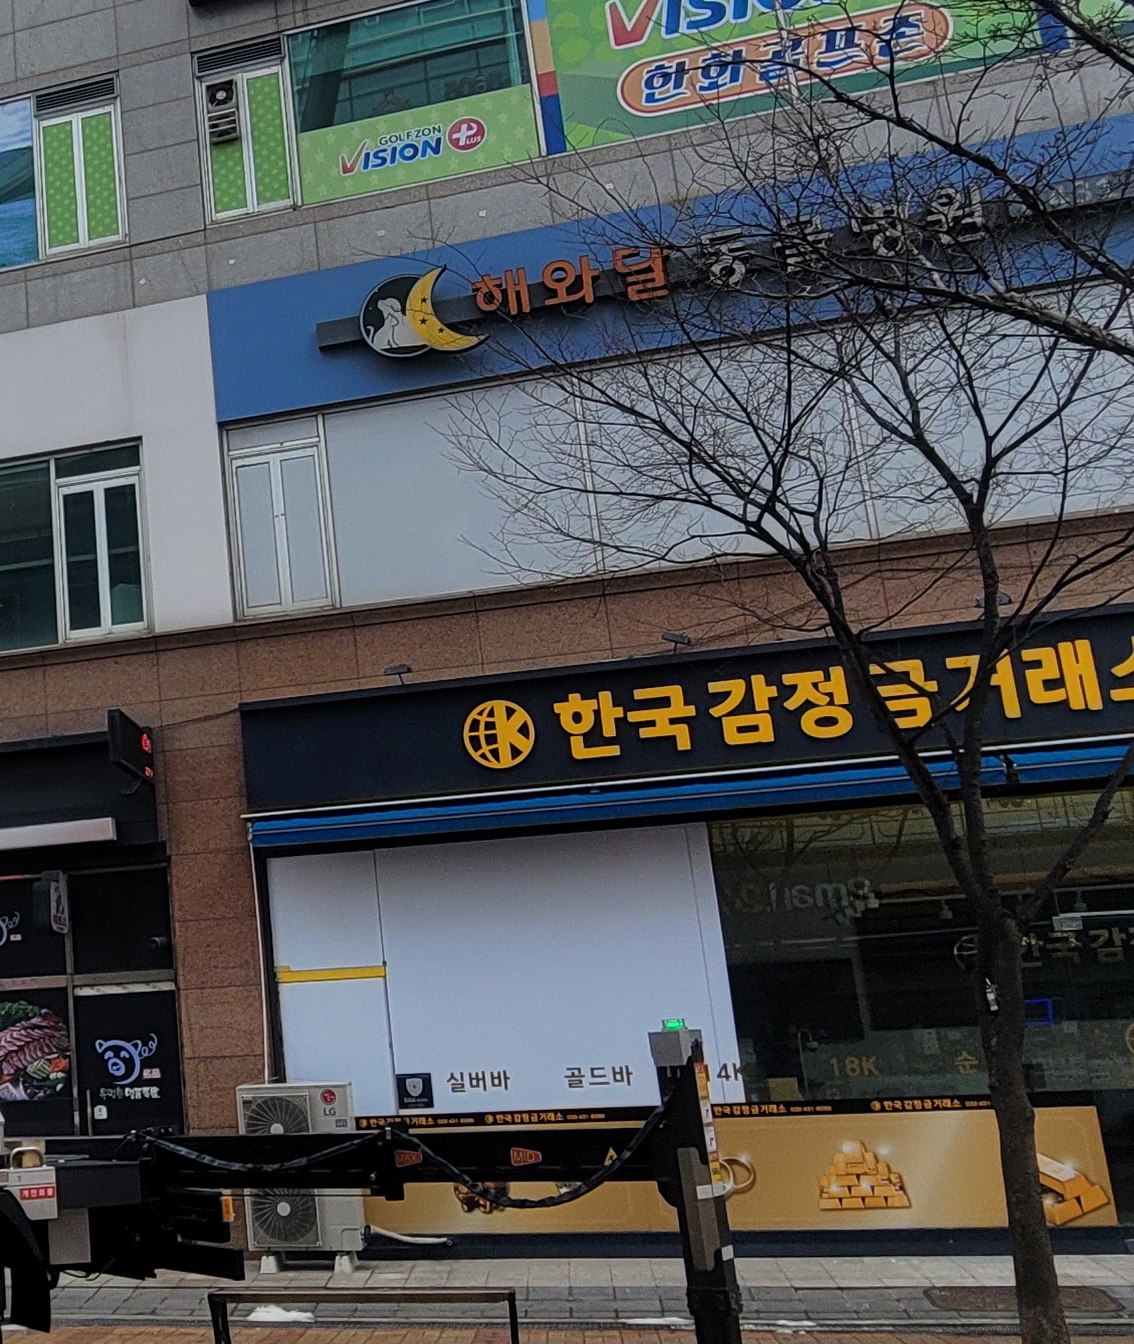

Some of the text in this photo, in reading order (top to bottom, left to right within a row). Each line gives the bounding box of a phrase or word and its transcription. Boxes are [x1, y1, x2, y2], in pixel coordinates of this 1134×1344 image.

[378, 124, 442, 146] GOLFZON
[341, 137, 443, 175] VISION
[471, 245, 670, 316] 해와달
[446, 1069, 511, 1094] 실버바
[563, 1064, 634, 1089] 골드바
[323, 1107, 337, 1117] LG
[512, 1150, 537, 1164] MID
